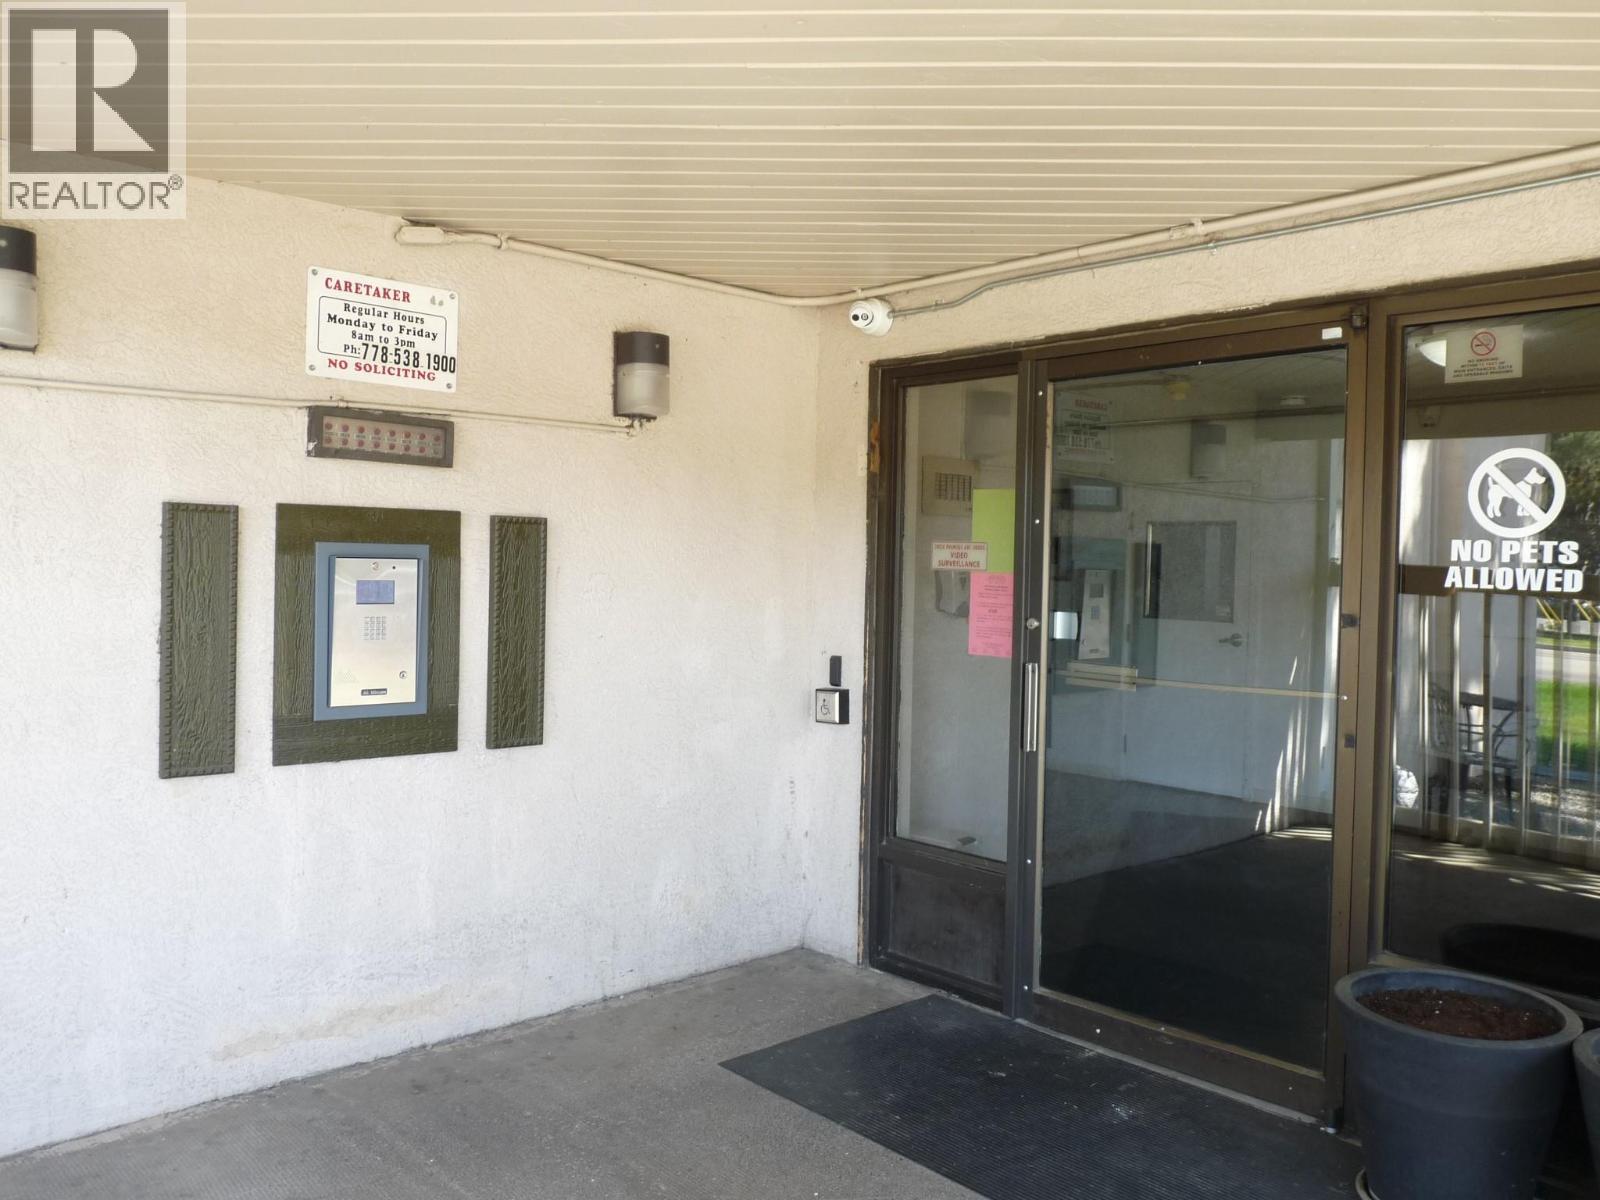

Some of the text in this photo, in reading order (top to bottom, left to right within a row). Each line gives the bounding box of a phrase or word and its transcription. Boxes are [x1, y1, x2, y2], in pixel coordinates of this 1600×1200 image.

[325, 277, 411, 303] CARETAKER
[343, 302, 425, 325] Regular Hours
[327, 313, 438, 341] Monday to Friday
[351, 330, 416, 348] 8am to 3pm
[327, 358, 436, 381] NO SOLICITING
[937, 559, 981, 568] SURVEILLANCE
[950, 551, 969, 559] VIDEO
[1450, 539, 1580, 565] NO PETS
[1444, 565, 1584, 593] ALLOWED
